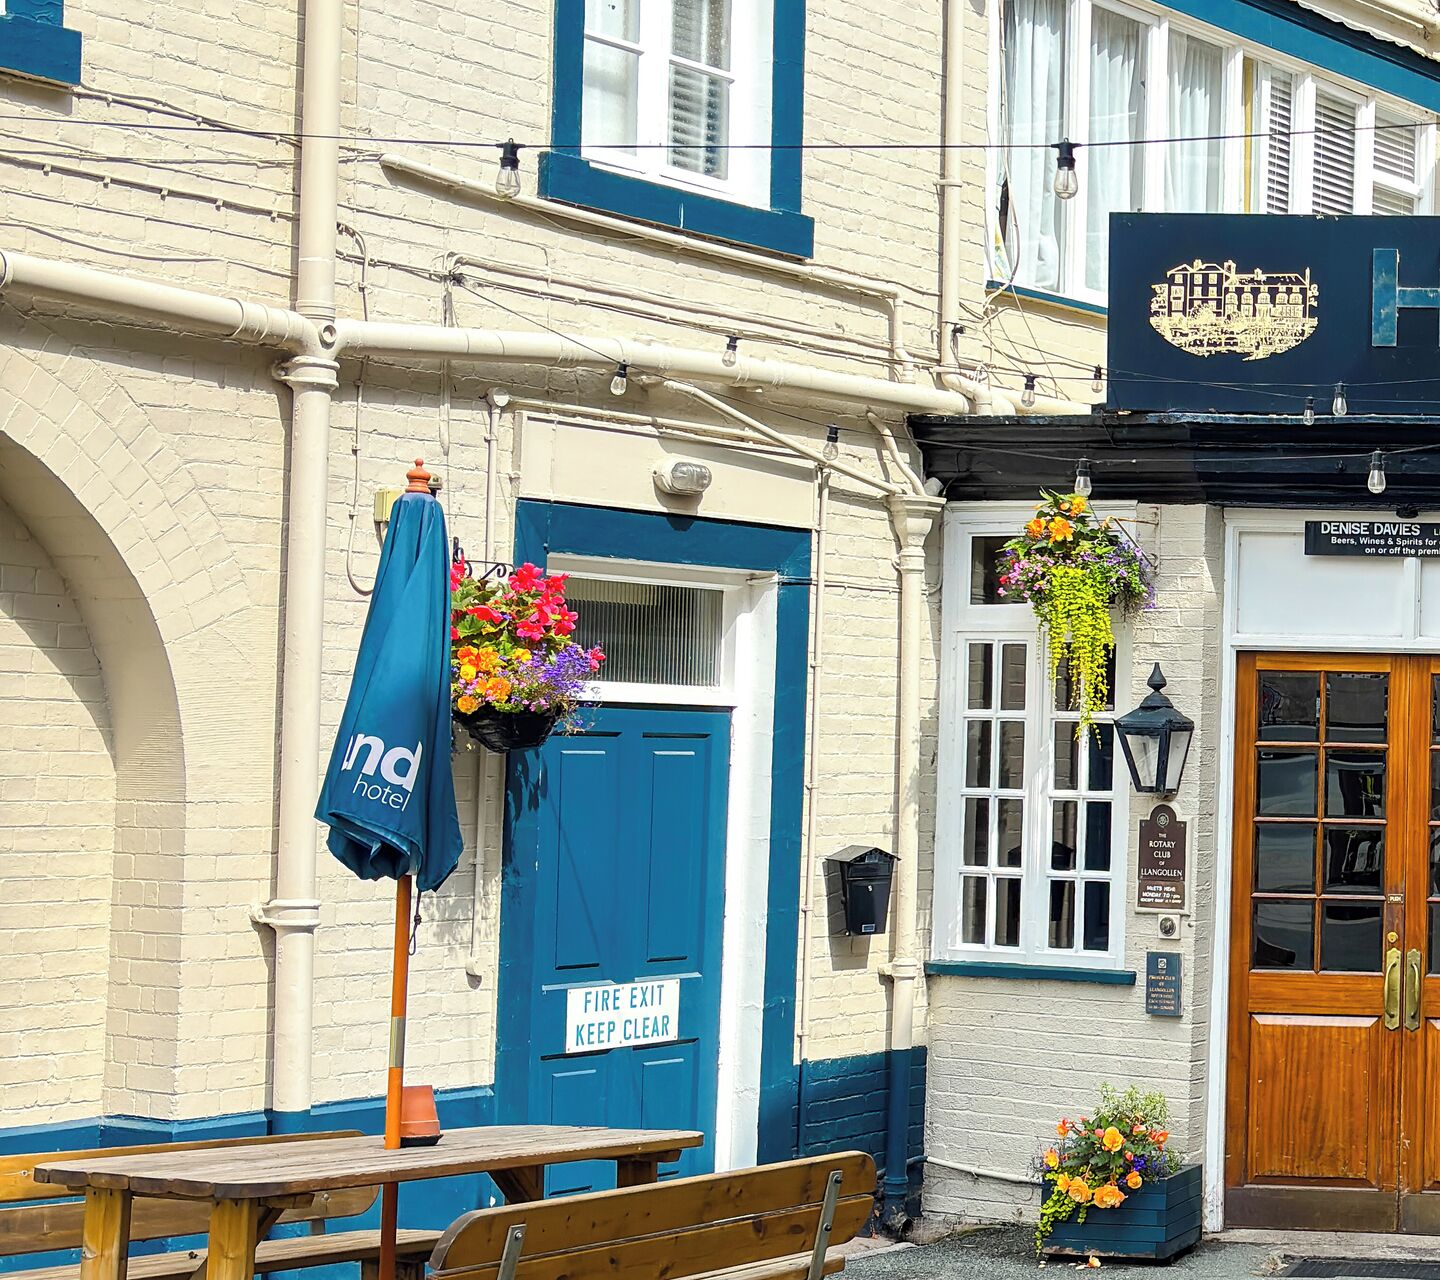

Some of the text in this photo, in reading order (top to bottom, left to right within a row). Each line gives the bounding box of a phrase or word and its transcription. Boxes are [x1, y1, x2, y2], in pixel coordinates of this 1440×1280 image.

[1320, 522, 1370, 535] DENISE
[1373, 523, 1421, 536] DAVIES
[1331, 536, 1358, 546] Beers,
[1360, 536, 1385, 545] Wines
[1396, 537, 1423, 547] Spirits
[1425, 537, 1437, 546] for
[1389, 546, 1402, 554] off
[1402, 547, 1416, 555] the
[352, 773, 411, 812] hotel
[1149, 840, 1177, 848] ROTARY
[1153, 850, 1171, 858] CLUB
[1141, 868, 1183, 877] LLANGOLLEN
[583, 984, 665, 1014] FIRE EXIT
[575, 1014, 670, 1047] KEEP CLEAR
